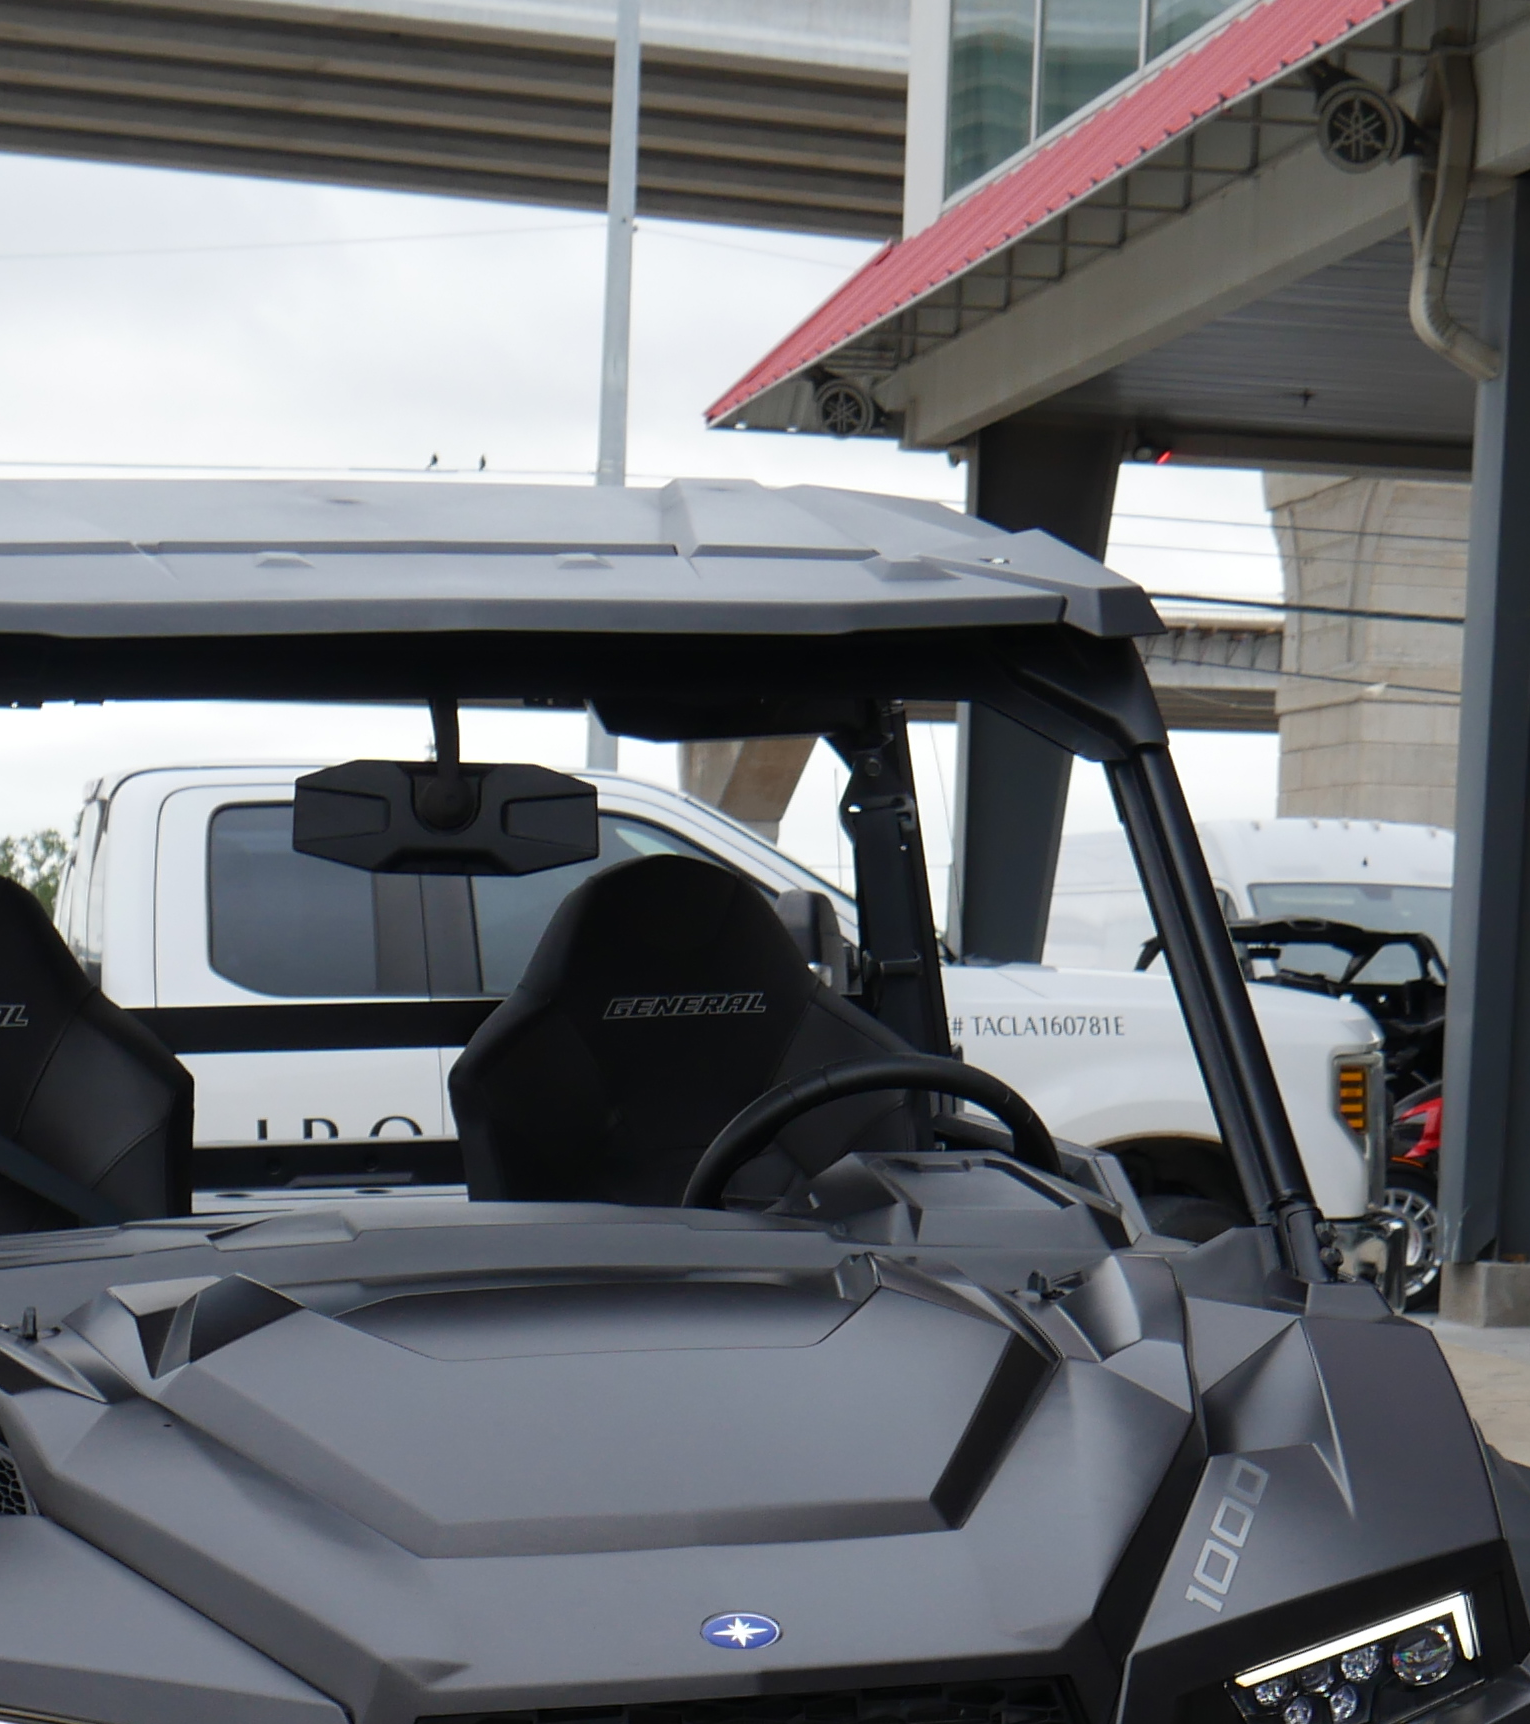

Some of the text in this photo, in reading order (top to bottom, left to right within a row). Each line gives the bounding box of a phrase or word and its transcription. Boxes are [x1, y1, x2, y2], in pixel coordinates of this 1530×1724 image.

[603, 993, 767, 1020] GENERAL
[971, 1014, 1127, 1037] TACLA160781E
[1184, 1458, 1270, 1614] 1000
